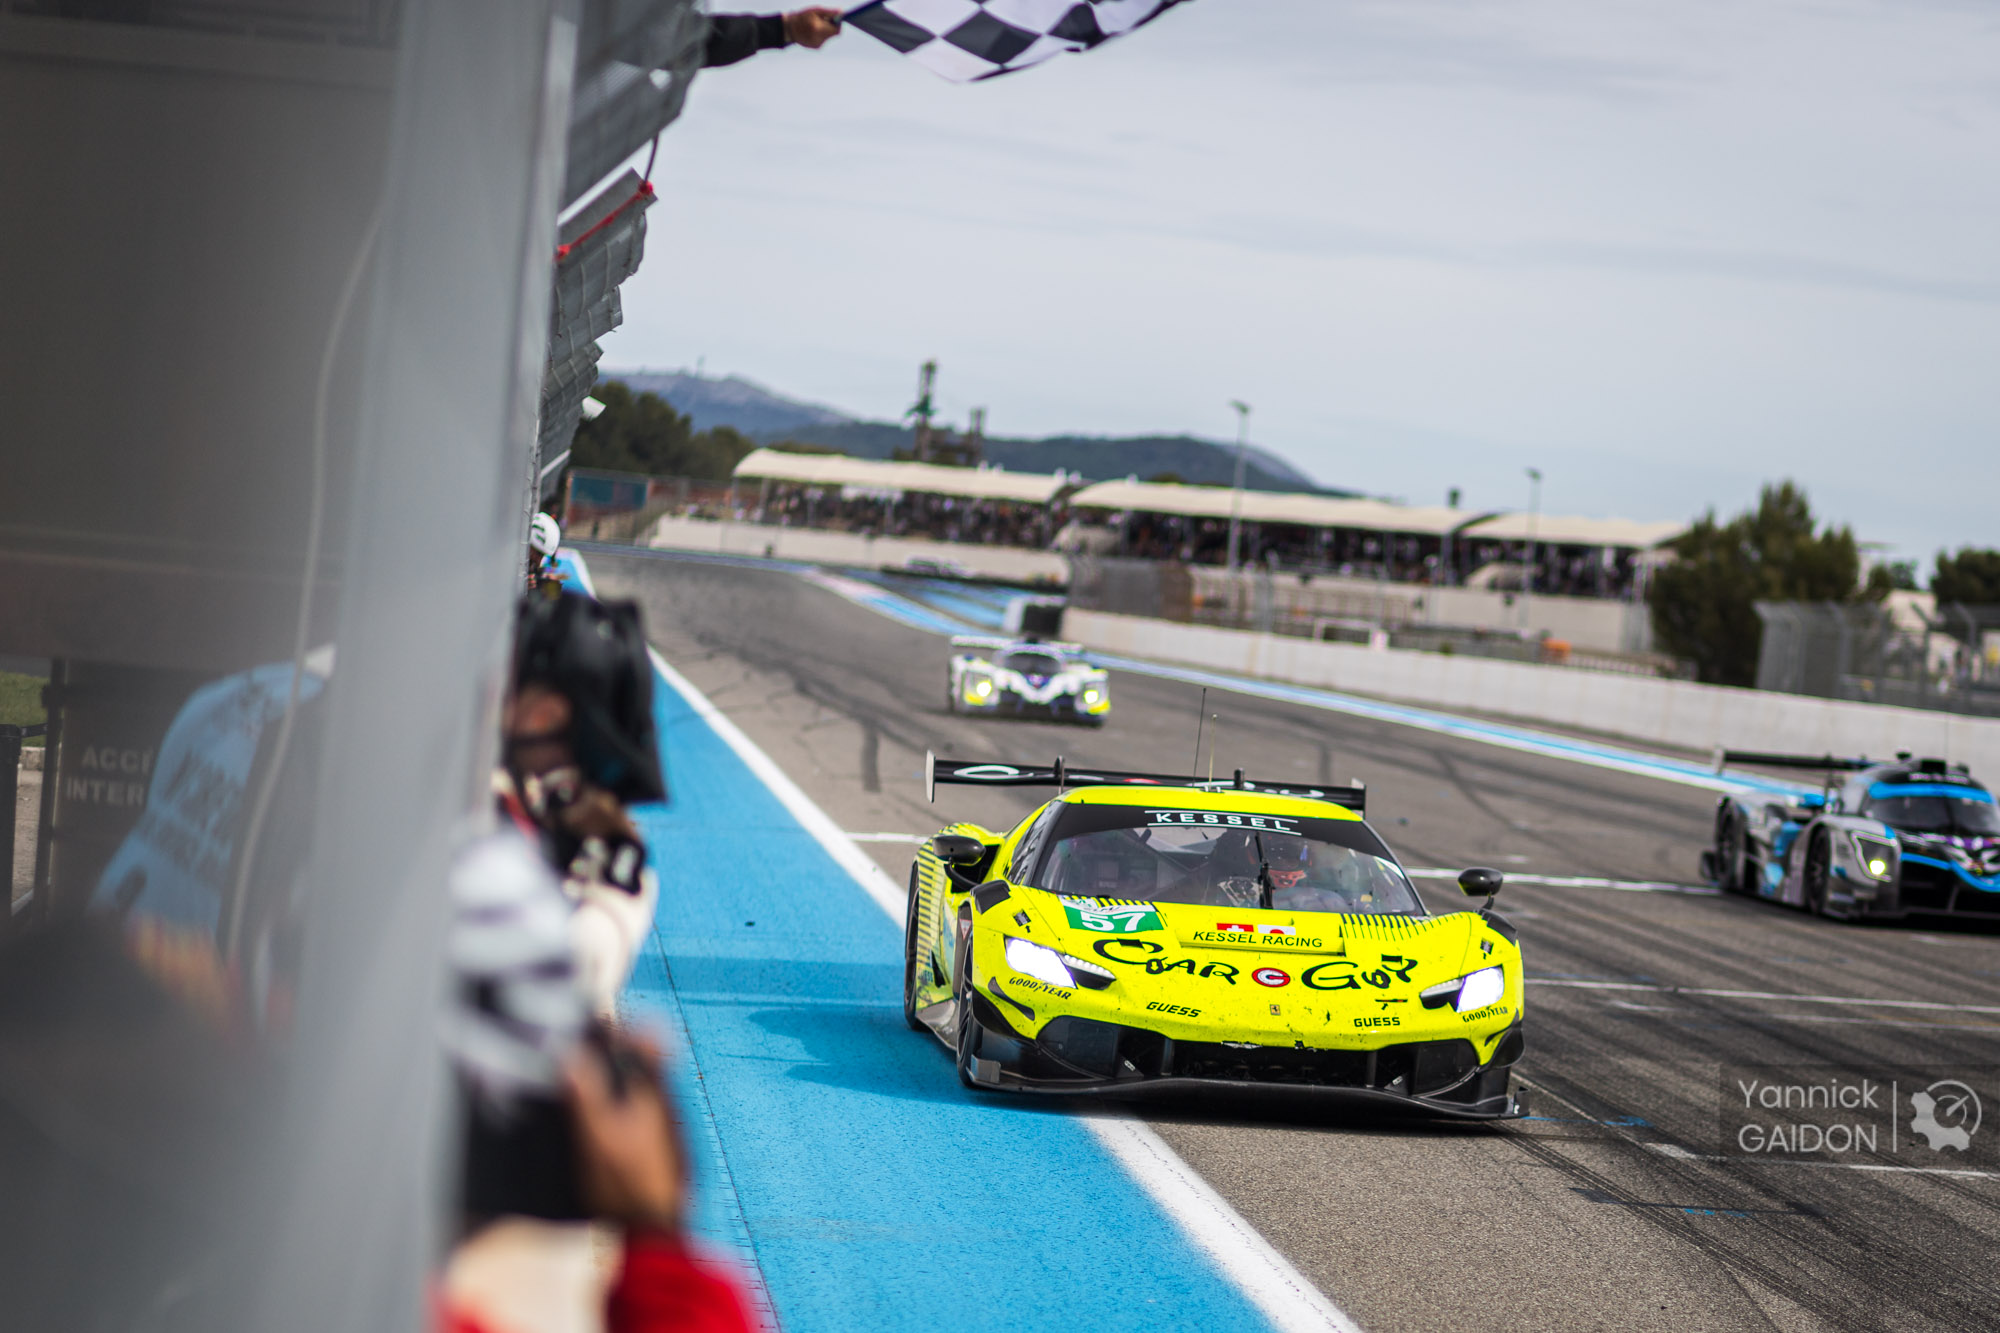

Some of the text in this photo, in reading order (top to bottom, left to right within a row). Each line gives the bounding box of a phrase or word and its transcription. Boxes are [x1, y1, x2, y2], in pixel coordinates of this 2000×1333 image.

[1156, 813, 1290, 831] KESSEL
[1080, 911, 1146, 931] 57
[1193, 930, 1323, 948] KESSEL RACING
[1009, 976, 1072, 1000] GOODYEAR
[1146, 1001, 1202, 1018] GUESS
[1353, 1016, 1401, 1027] GUESS
